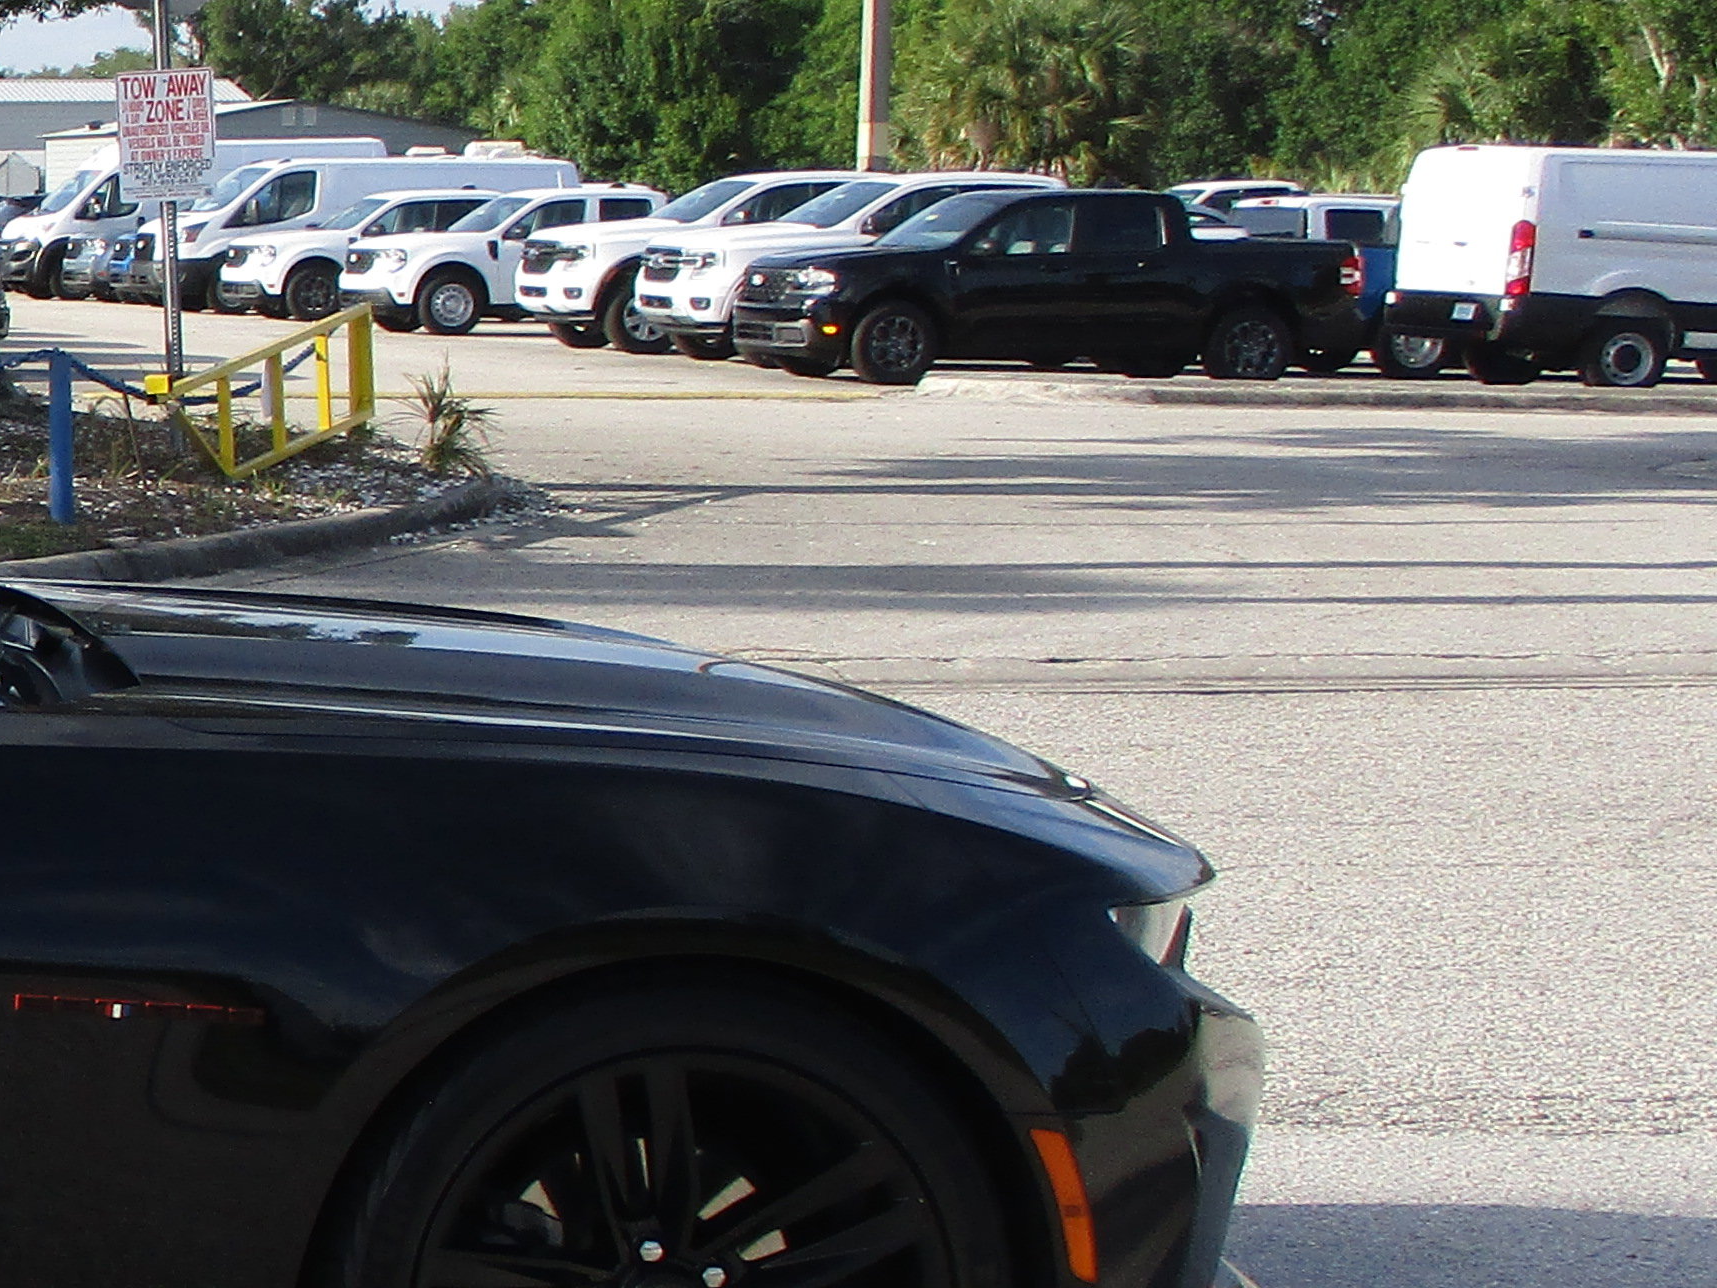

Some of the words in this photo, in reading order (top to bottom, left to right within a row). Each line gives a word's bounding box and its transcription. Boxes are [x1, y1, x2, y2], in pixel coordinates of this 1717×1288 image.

[120, 76, 157, 100] TOW
[166, 73, 207, 97] AWAY
[146, 99, 184, 122] ZONE
[123, 161, 164, 175] STRICTLY
[165, 159, 213, 172] ENFORCED
